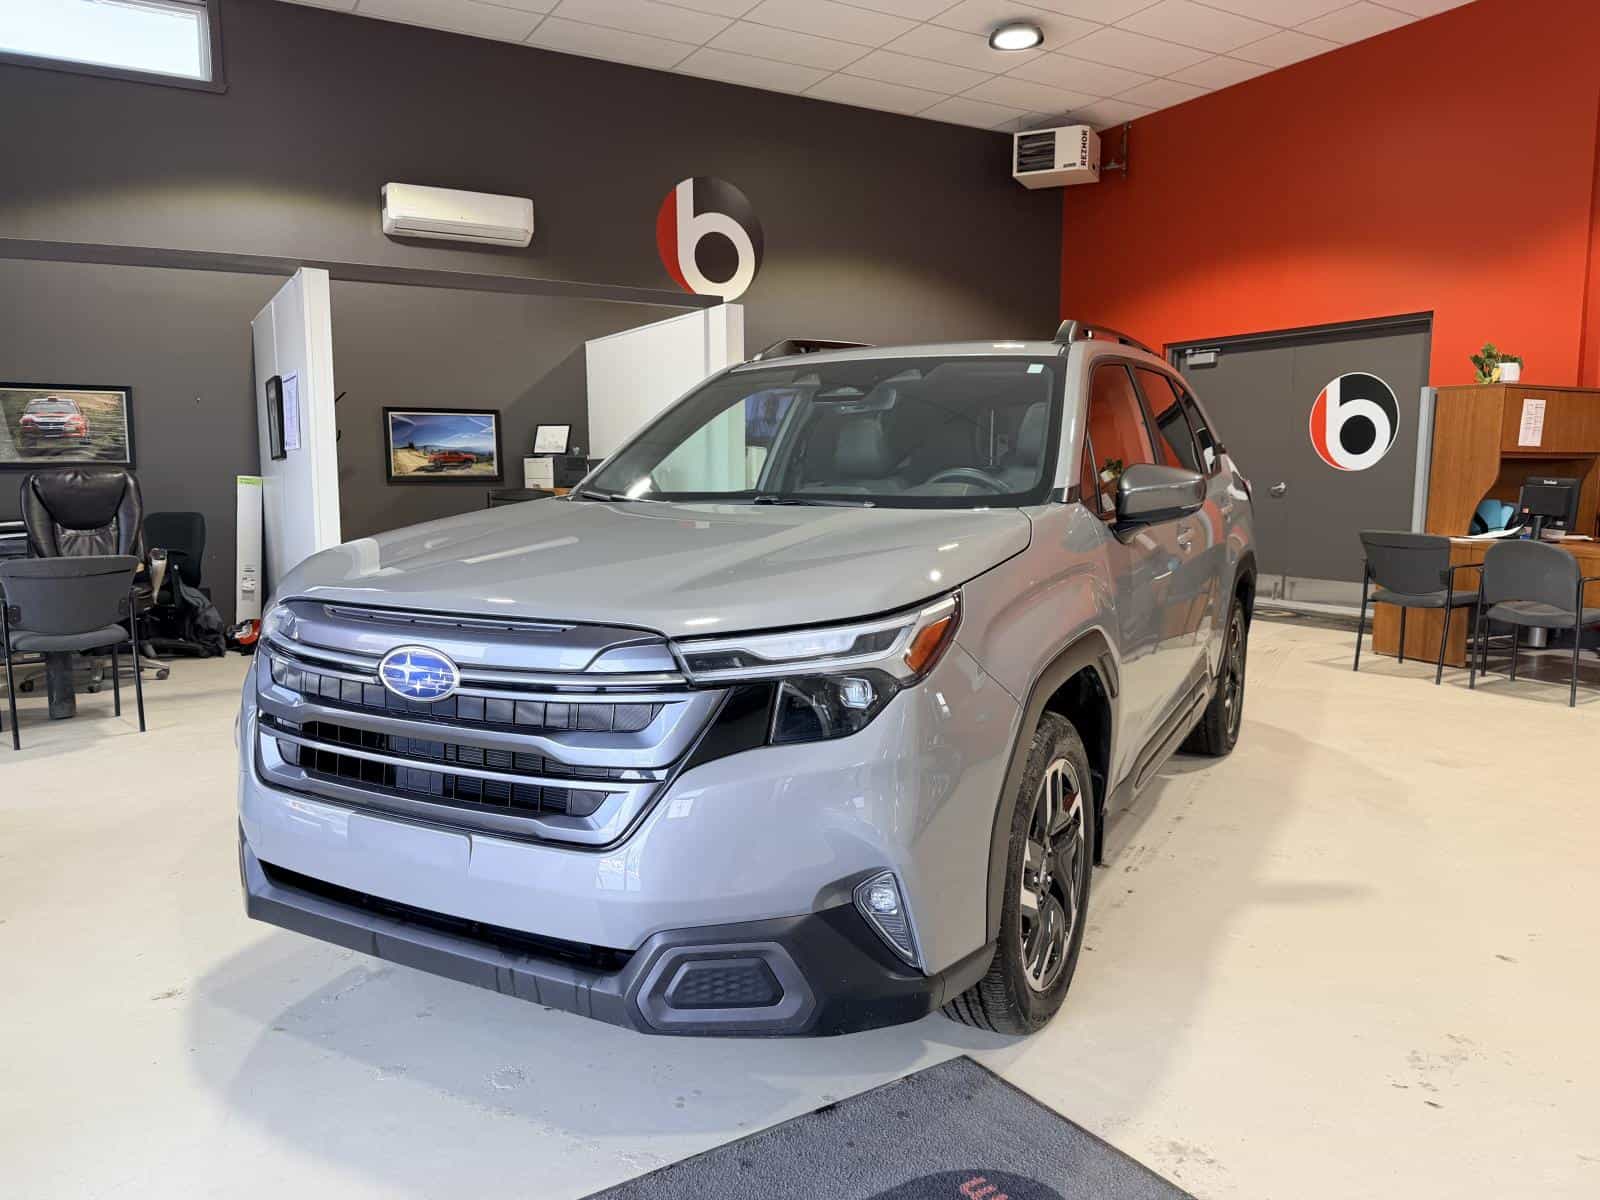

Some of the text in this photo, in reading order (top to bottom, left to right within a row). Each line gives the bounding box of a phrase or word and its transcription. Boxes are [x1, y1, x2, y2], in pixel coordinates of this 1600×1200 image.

[1080, 129, 1089, 167] REZNOR
[676, 177, 755, 303] b
[1325, 375, 1391, 471] b
